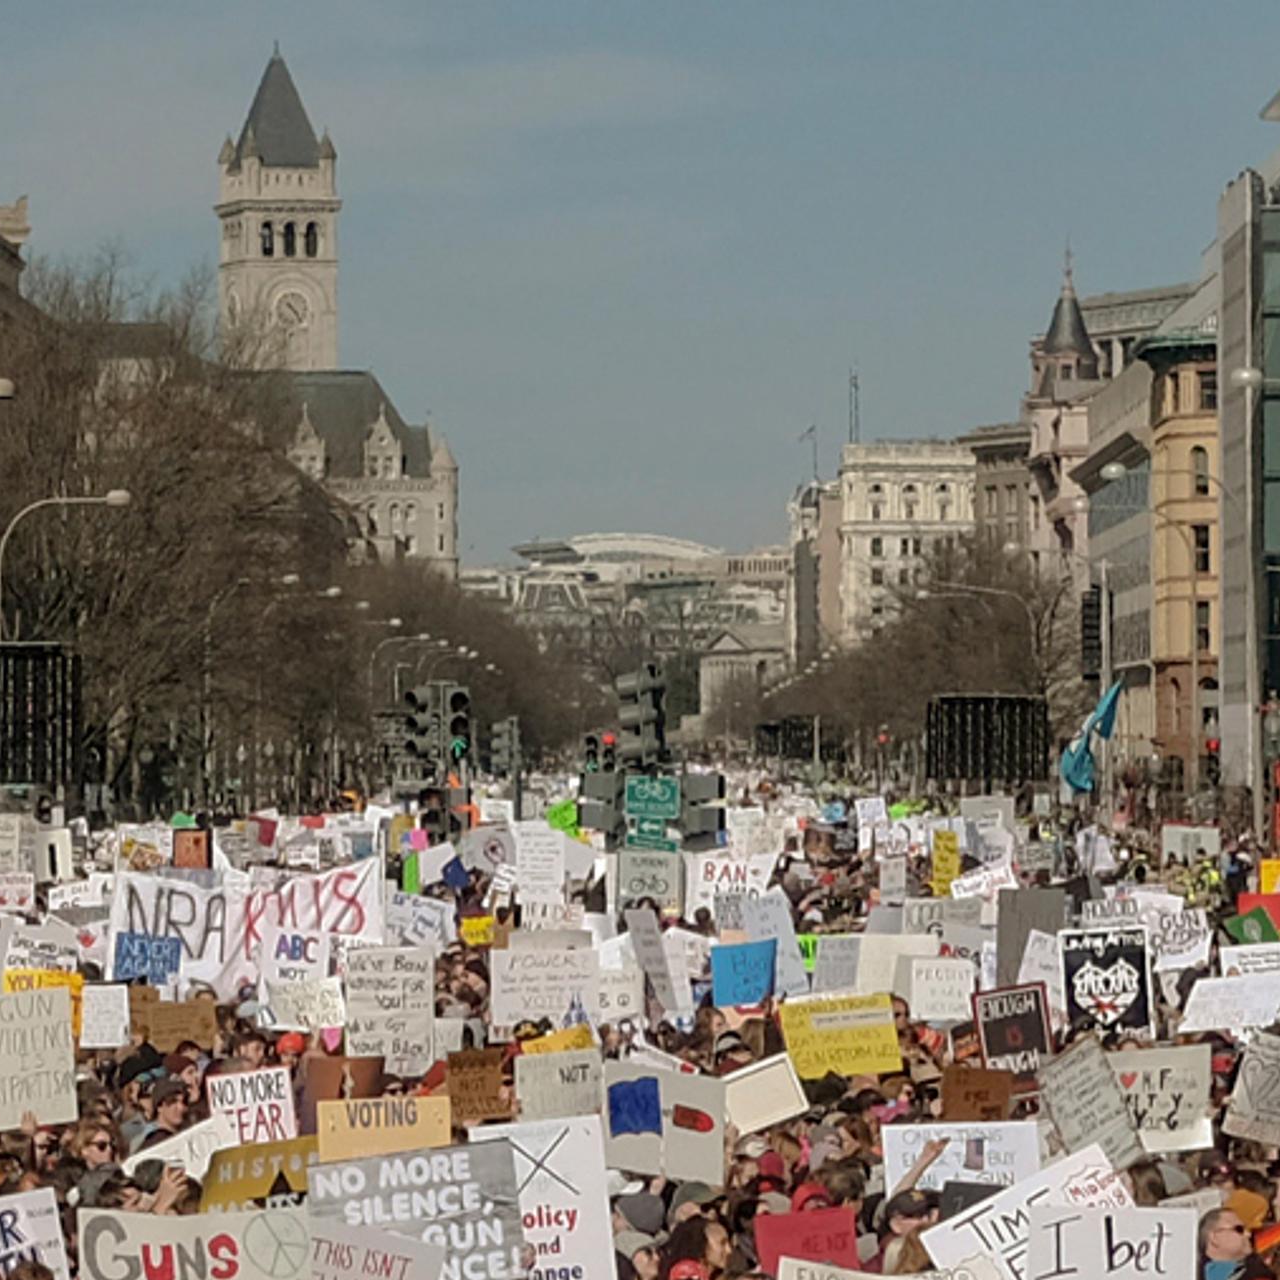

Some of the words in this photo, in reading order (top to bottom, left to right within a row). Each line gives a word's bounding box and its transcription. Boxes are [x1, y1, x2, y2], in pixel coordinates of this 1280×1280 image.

[704, 861, 746, 882] BAN
[276, 934, 318, 962] ABC
[982, 993, 1035, 1021] ENOUGH
[211, 1078, 234, 1108] NO
[240, 1072, 285, 1100] MORE
[346, 1102, 417, 1128] VOTING
[315, 1165, 365, 1199] NO
[379, 1152, 470, 1182] MORE
[1036, 1213, 1082, 1280] I
[1105, 1215, 1166, 1274] bet
